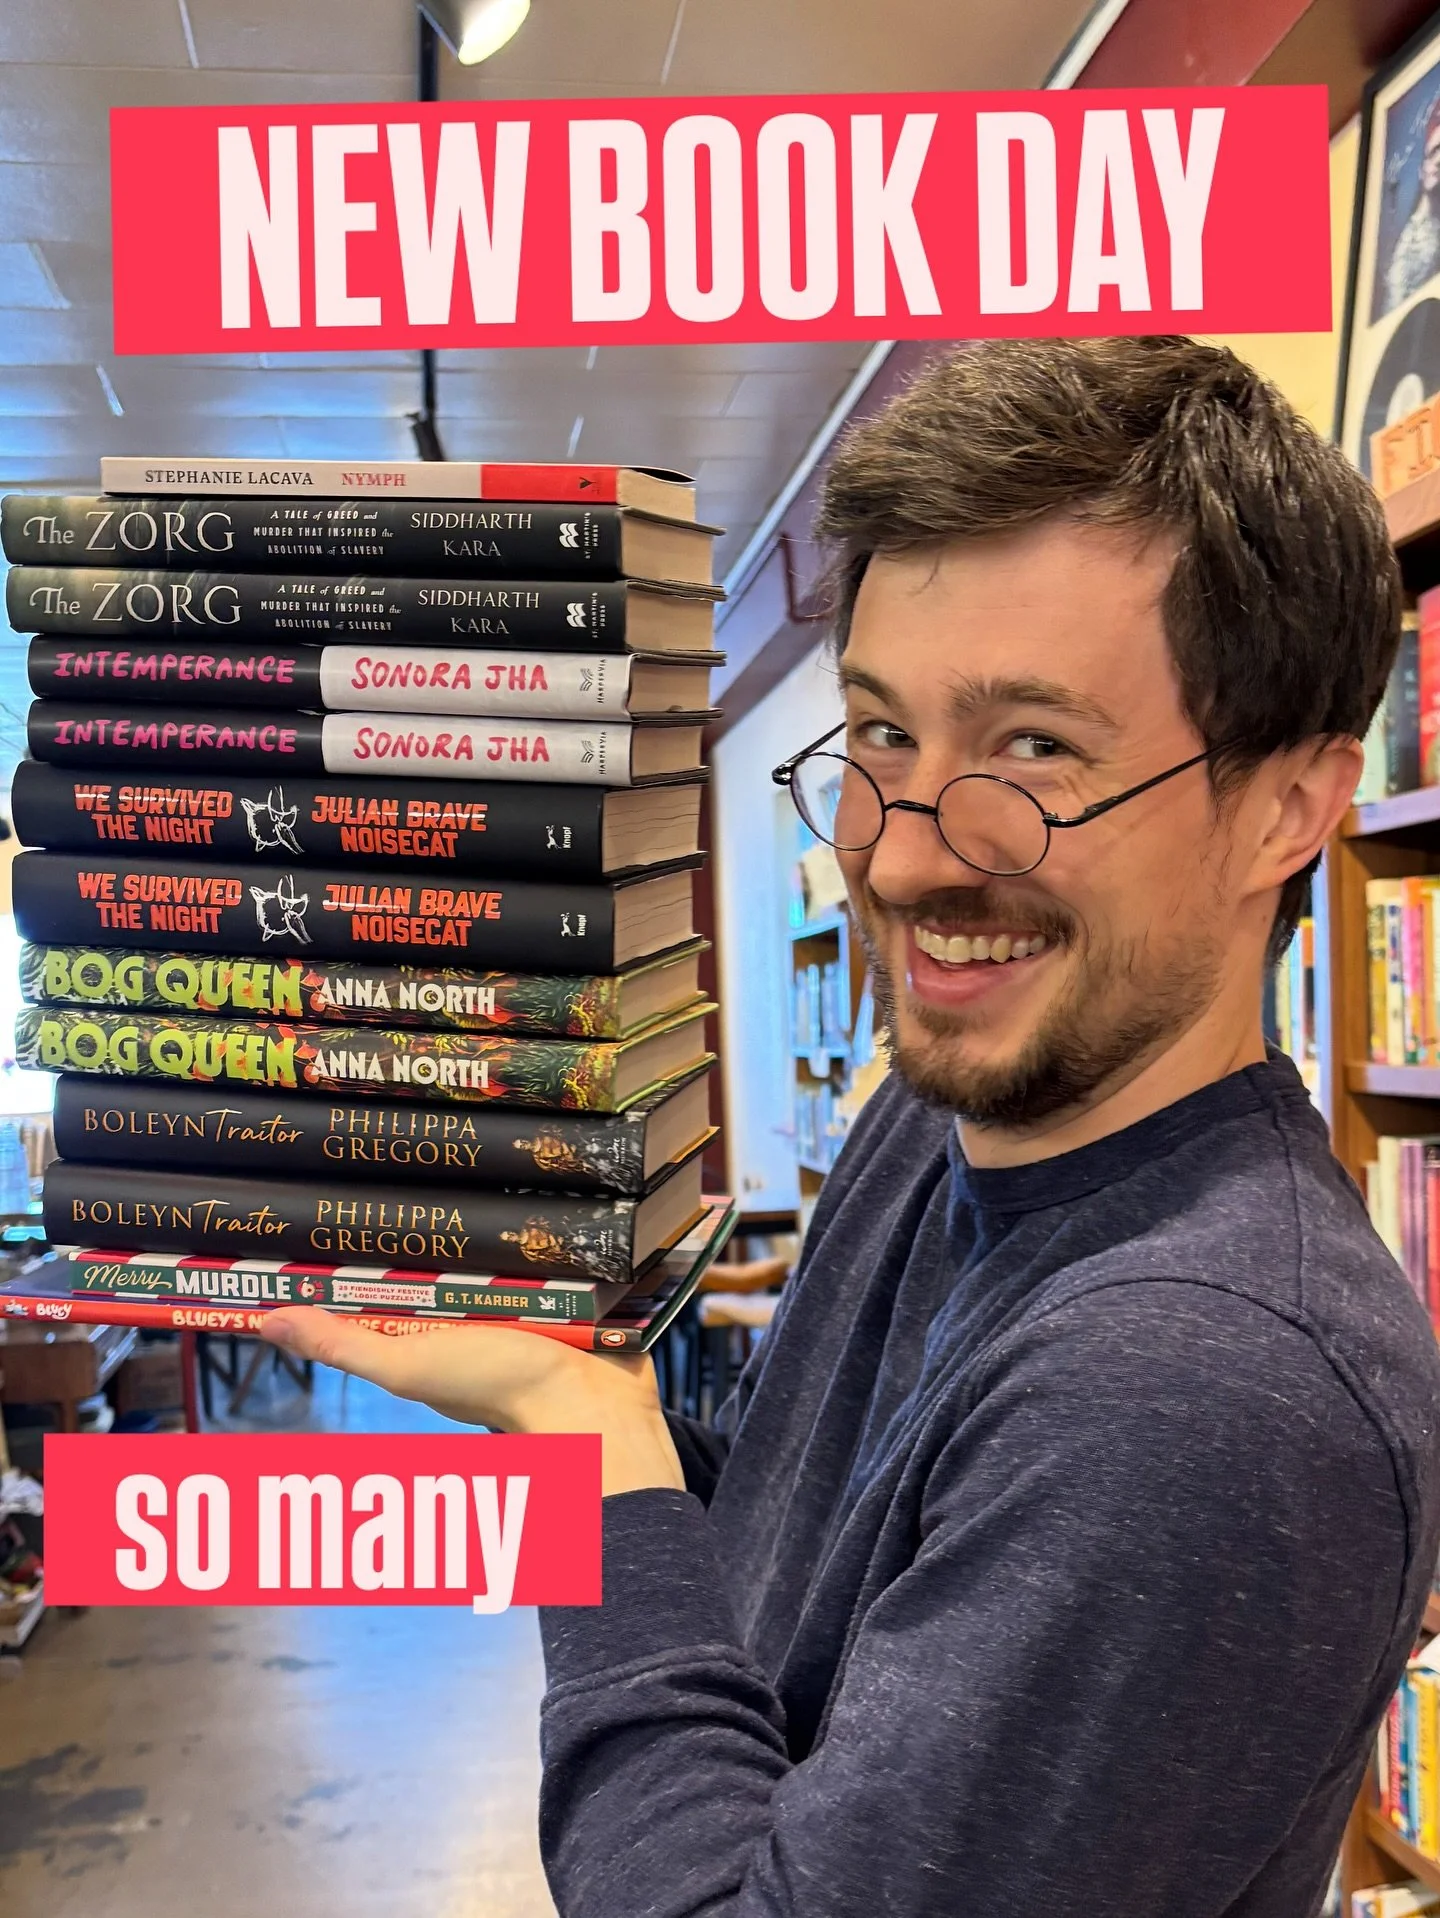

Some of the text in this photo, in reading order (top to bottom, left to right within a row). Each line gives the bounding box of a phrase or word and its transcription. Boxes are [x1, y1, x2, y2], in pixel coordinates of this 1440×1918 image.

[145, 470, 314, 486] STEPHANIE LACAVA
[341, 472, 407, 488] NYMPH
[270, 510, 378, 521] A TALE of GREED and
[410, 511, 533, 530] SIDDHARTH
[23, 511, 236, 553] The ZORG
[253, 527, 394, 538] MURDER THAT INSPIRED the
[443, 539, 502, 557] KARA
[267, 545, 323, 555] ABOLITION
[340, 545, 384, 555] SLAVERY
[29, 583, 243, 625] The ZORG
[277, 584, 385, 596] A TALE of GREED and
[417, 589, 540, 609] SIDDHARTH
[260, 601, 402, 614] MURDER THAT INSPIRED the
[274, 618, 330, 629] ABOLITION
[349, 620, 392, 631] SLAVERY
[450, 616, 510, 635] KARA
[54, 650, 297, 684] INTEMPERANCE
[351, 656, 549, 692] SONORA JHA
[54, 719, 298, 753] INTEMPERANCE
[353, 727, 550, 763] SONORA JHA
[73, 784, 234, 818] WE SURVIVED
[311, 795, 488, 832] JULIAN BRAVE
[91, 813, 215, 845] THE NIGHT
[340, 825, 459, 858] NOISECAT
[562, 826, 572, 849] Knopf
[77, 872, 243, 907] WE SURVIVED
[322, 884, 503, 920] JULIAN BRAVE
[95, 902, 223, 934] THE NIGHT
[351, 914, 473, 947] NOISECAT
[577, 914, 587, 937] Knopf
[45, 951, 304, 1017] BOG QUEEN
[316, 977, 496, 1015] ANNA NORTH
[37, 1019, 298, 1088] BOG QUEEN
[310, 1050, 490, 1088] ANNA NORTH
[84, 1107, 305, 1145] BOLEYN Traitor
[329, 1108, 478, 1140] PHILIPPA
[322, 1135, 483, 1167] GREGORY
[72, 1199, 293, 1237] BOLEYN Traitor
[315, 1199, 466, 1232] PHILIPPA
[309, 1226, 471, 1259] GREGORY
[84, 1264, 292, 1300] Merry MURDLE
[350, 1286, 395, 1294] FIENDISHLY
[380, 1294, 415, 1302] PUZZLES
[444, 1292, 529, 1308] G. T. KARBER
[172, 1309, 245, 1329] BLUEY'S
